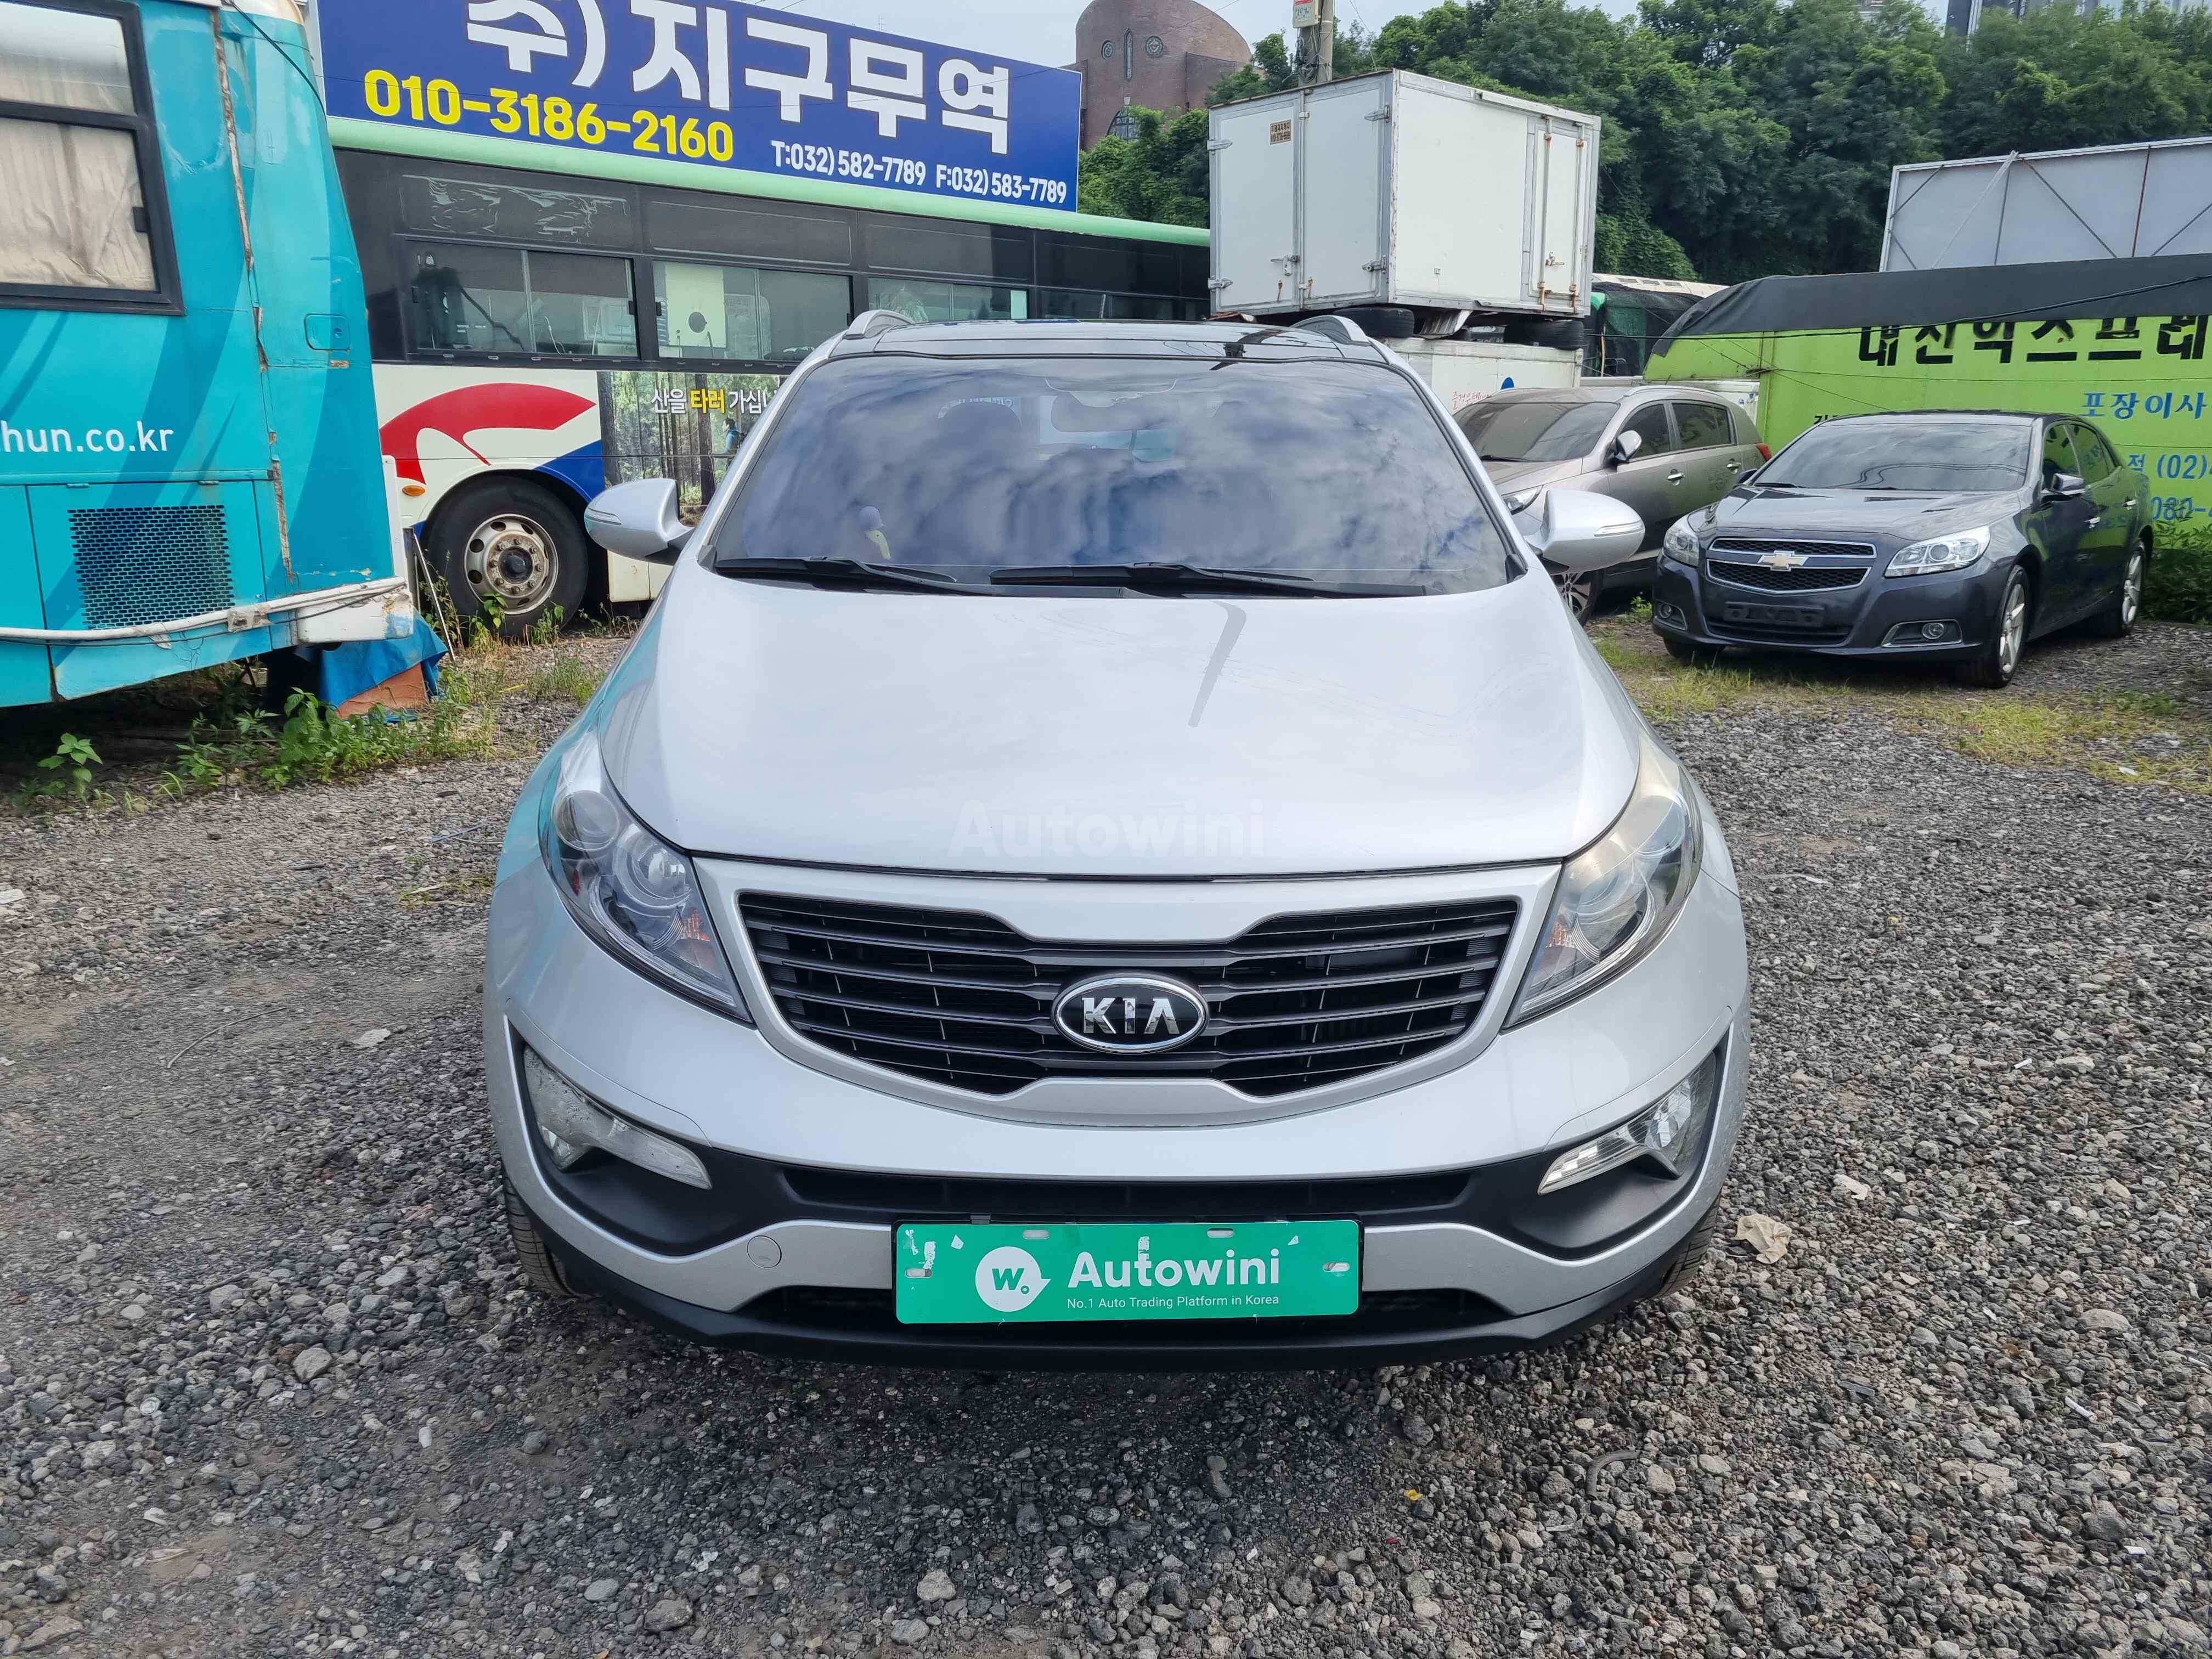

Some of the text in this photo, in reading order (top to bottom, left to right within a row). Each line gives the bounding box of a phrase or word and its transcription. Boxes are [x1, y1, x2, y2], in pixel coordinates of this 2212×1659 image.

[364, 69, 734, 161] 010-3186-2160
[651, 389, 686, 414] 산을
[690, 388, 726, 415] 타러
[2078, 392, 2207, 419] 포장이사
[0, 420, 174, 452] hun.co.kr
[2157, 454, 2212, 479] (02)
[1081, 997, 1180, 1035] KIA
[1068, 1248, 1280, 1288] Autowini
[1066, 1295, 1279, 1309] No.1 Auto Trading Platform in Korea
